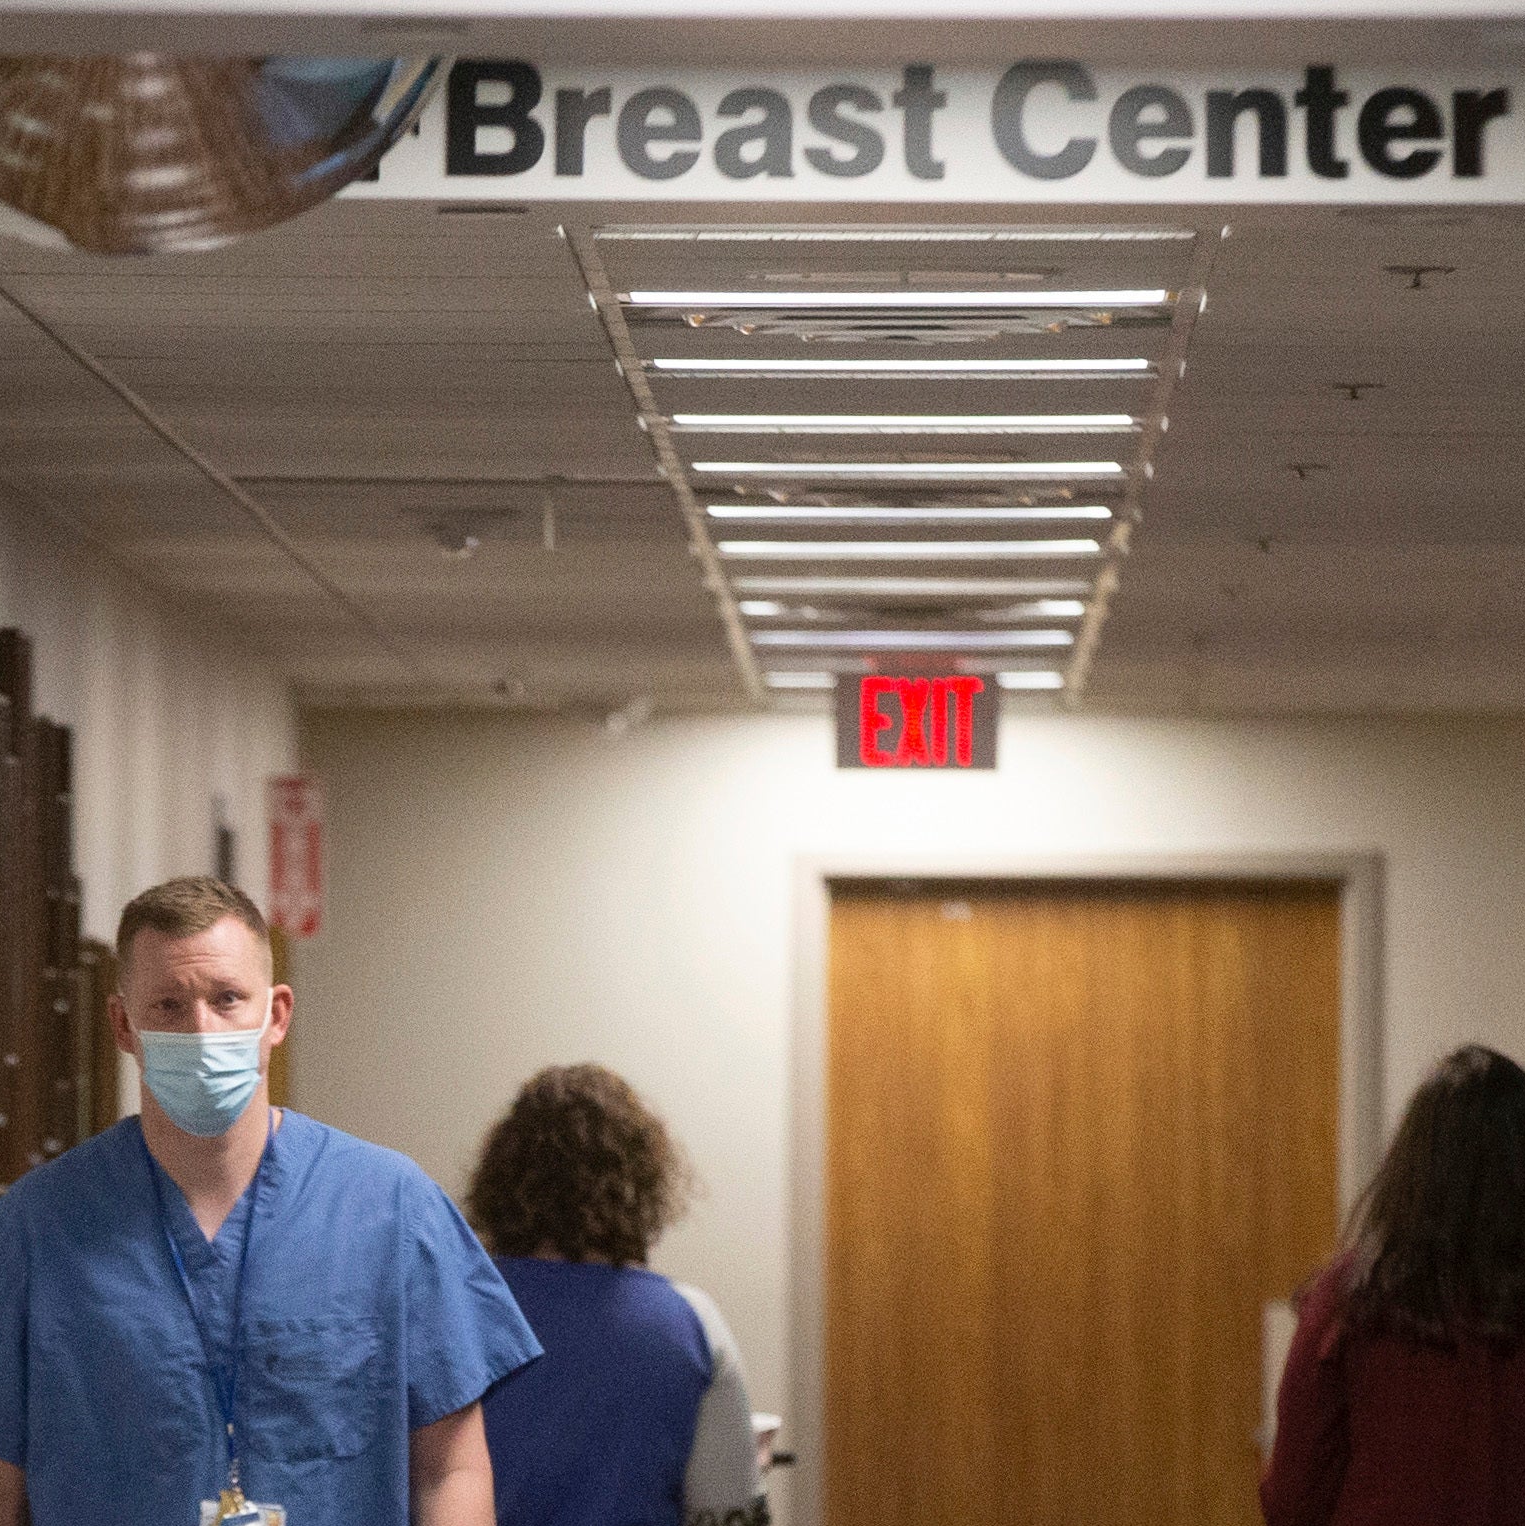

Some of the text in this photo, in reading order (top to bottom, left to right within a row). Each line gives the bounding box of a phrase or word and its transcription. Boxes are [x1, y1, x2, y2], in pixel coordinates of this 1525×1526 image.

[444, 58, 945, 180] Breast
[990, 58, 1510, 180] Center
[860, 676, 984, 767] EXIT
